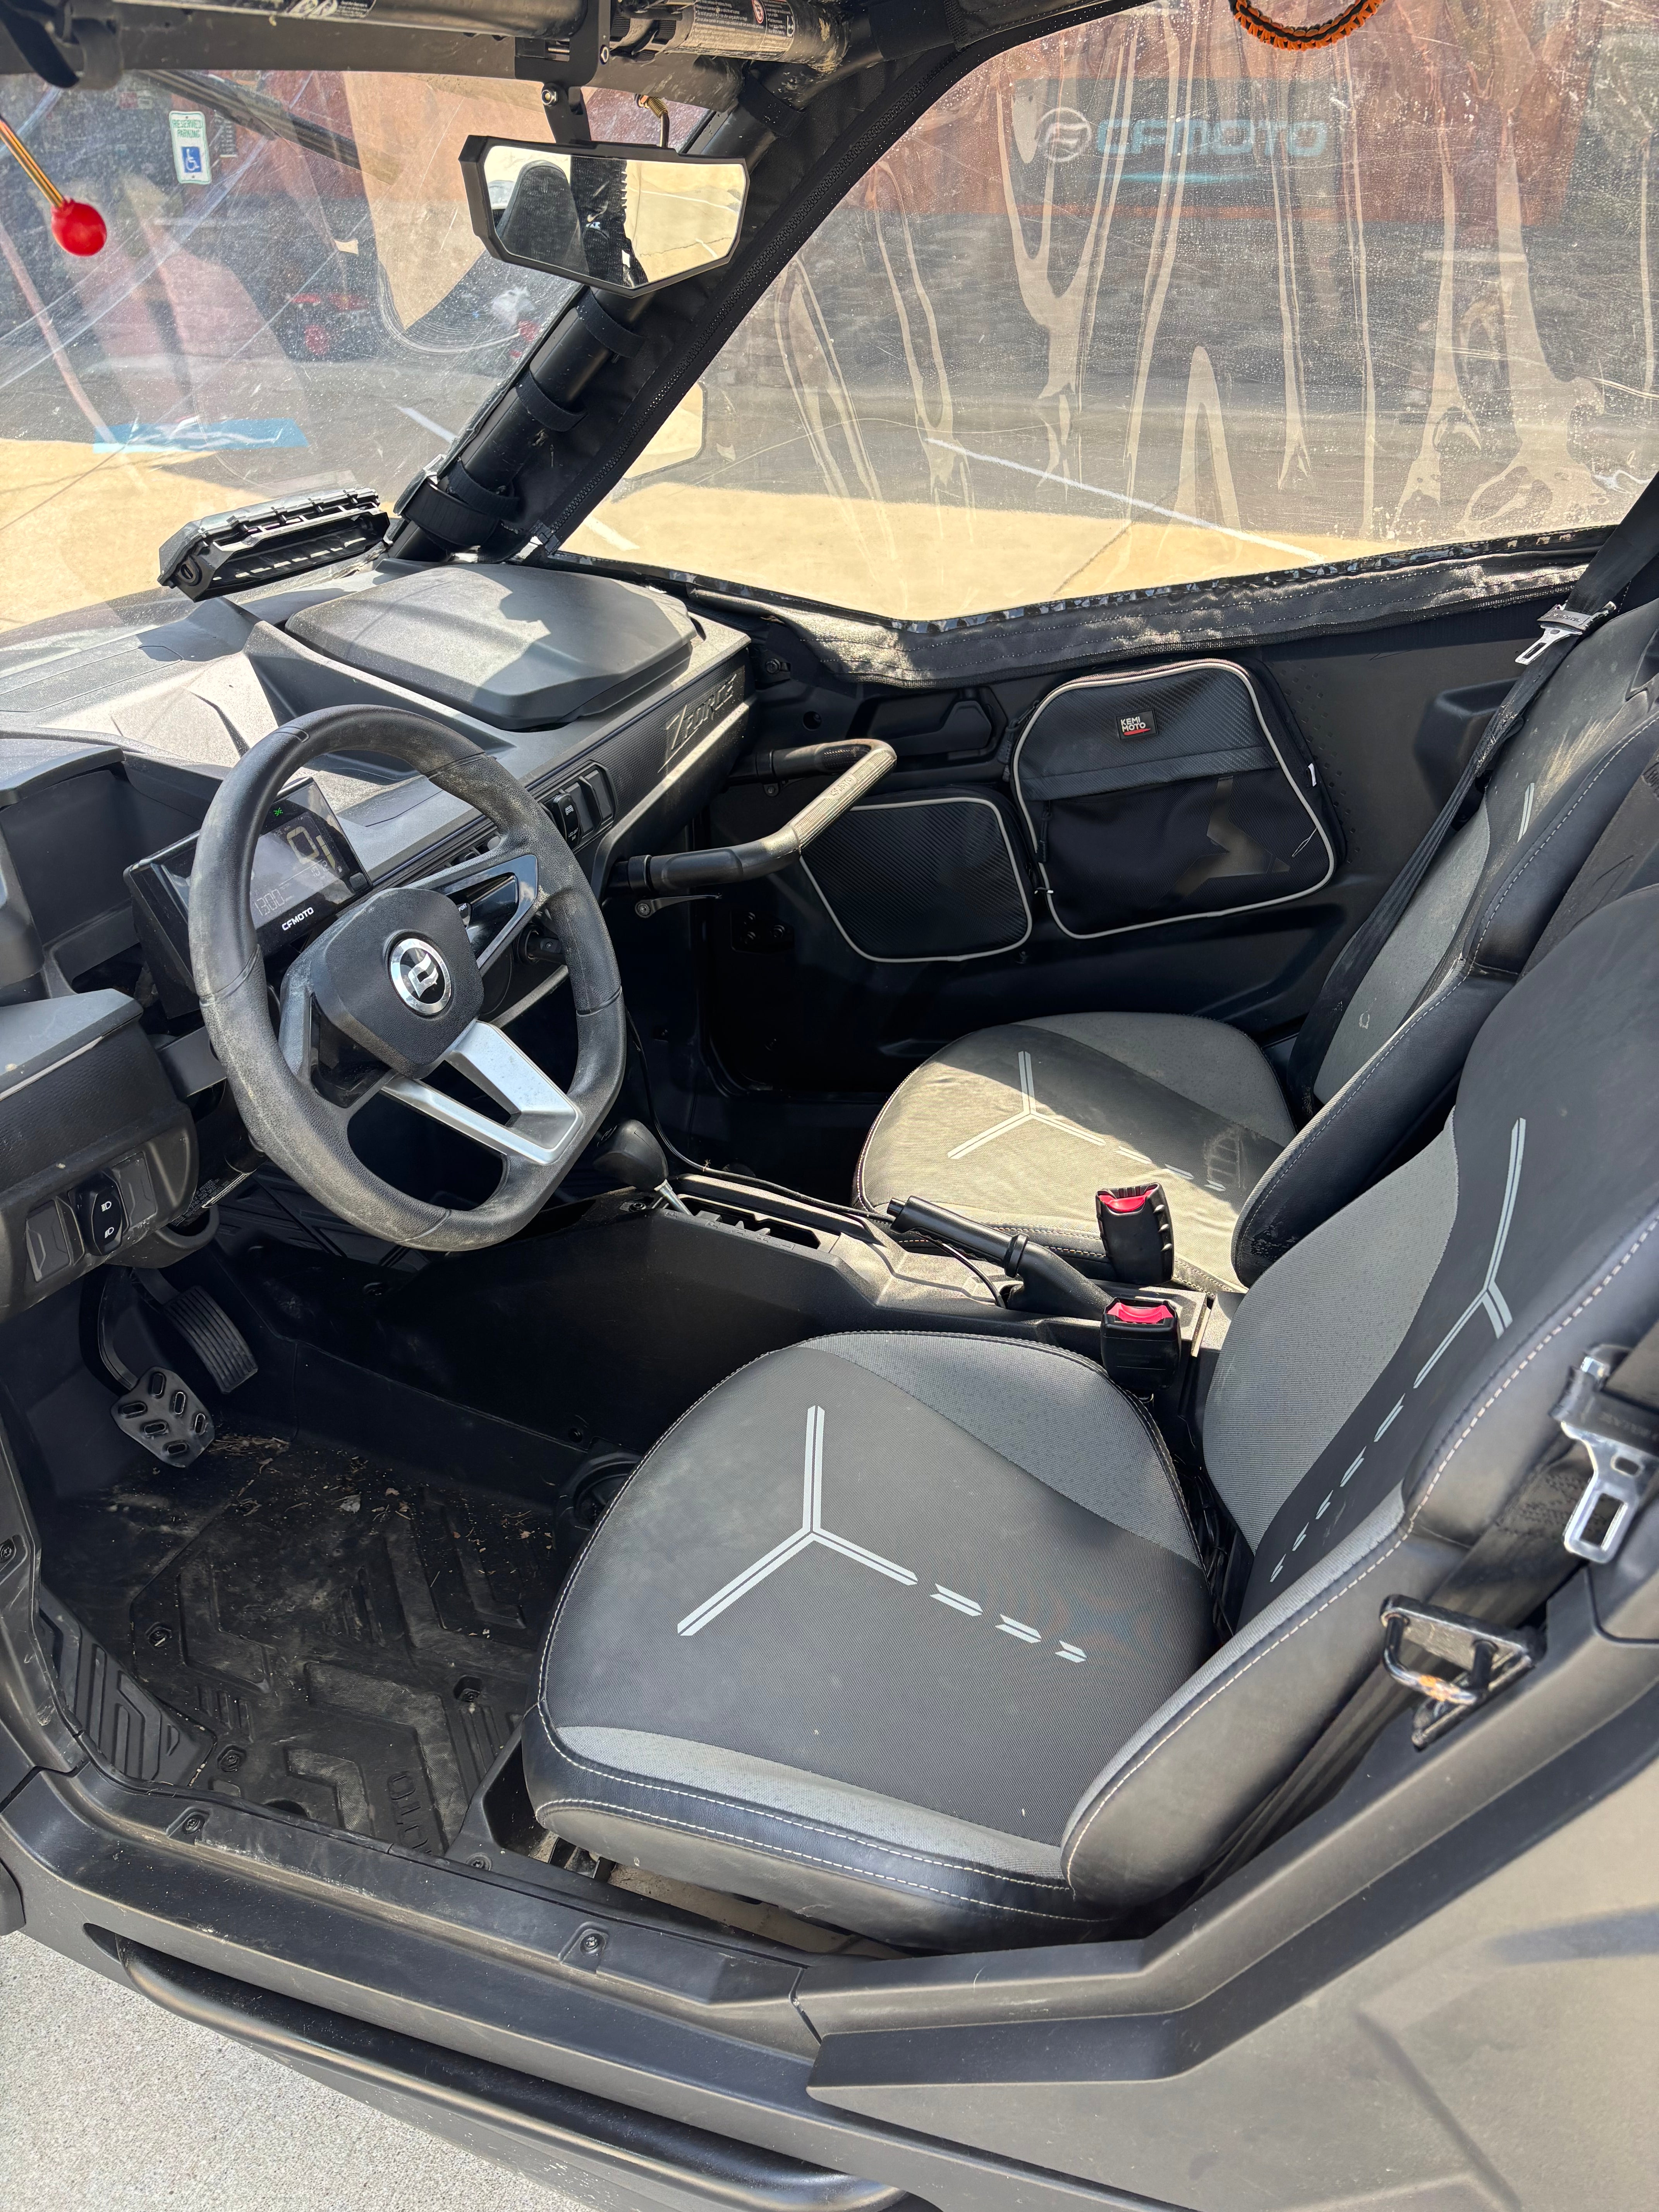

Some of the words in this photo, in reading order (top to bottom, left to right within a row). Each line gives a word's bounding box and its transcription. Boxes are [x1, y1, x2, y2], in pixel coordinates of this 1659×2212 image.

[172, 119, 203, 129] RESERVED
[177, 129, 201, 138] PARKING
[1096, 117, 1327, 156] CFMOTO
[1120, 716, 1141, 726] KEMI
[1121, 722, 1146, 732] MOTO
[282, 907, 314, 931] CFMOTO
